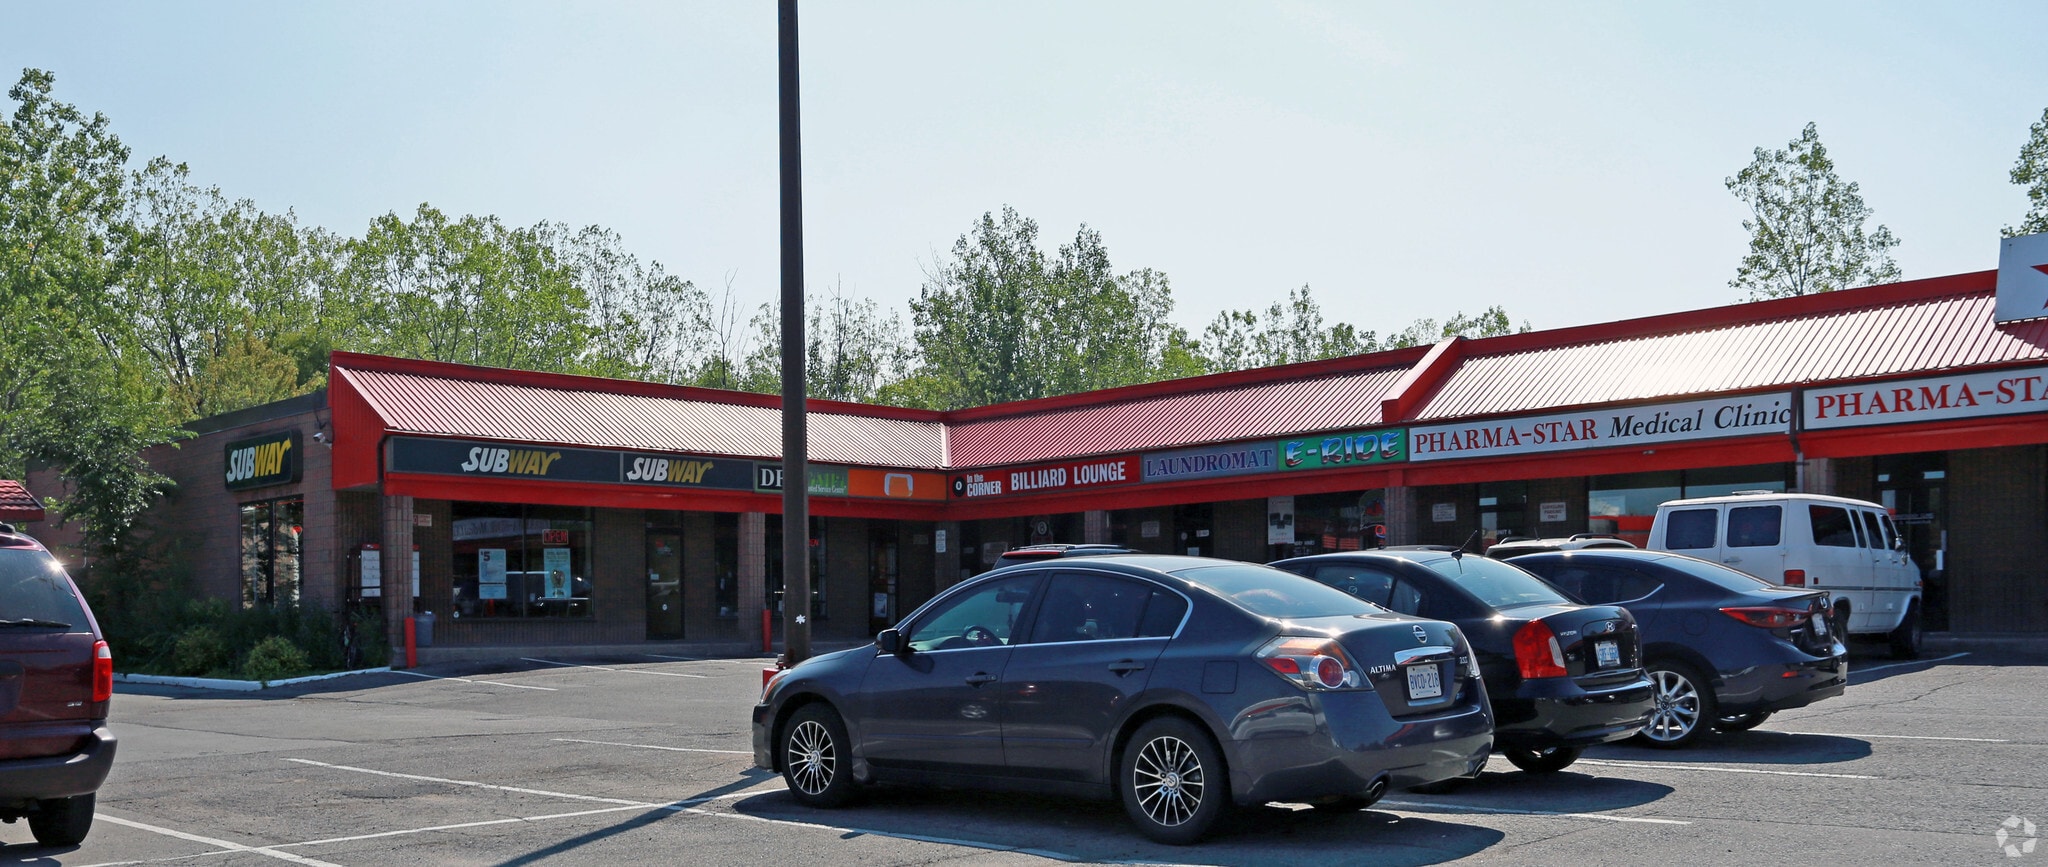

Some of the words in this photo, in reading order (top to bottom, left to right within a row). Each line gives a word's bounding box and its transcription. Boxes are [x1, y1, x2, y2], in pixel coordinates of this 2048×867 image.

[1414, 418, 1599, 455] PHARMA-STAR
[1607, 409, 1704, 439] Medical
[1713, 400, 1791, 430] Clinic
[226, 437, 292, 484] SUBWAY
[461, 446, 562, 476] SUBWAY
[1146, 449, 1274, 477] LAUNDROMAT
[1285, 431, 1401, 468] E-RIDE
[626, 457, 714, 484] SUBWAY
[1011, 467, 1067, 491] BILLIARD
[1073, 461, 1126, 485] LOUNGE
[966, 481, 1002, 497] CORNER
[544, 530, 568, 543] OPEN
[1370, 664, 1396, 674] ALTIMA
